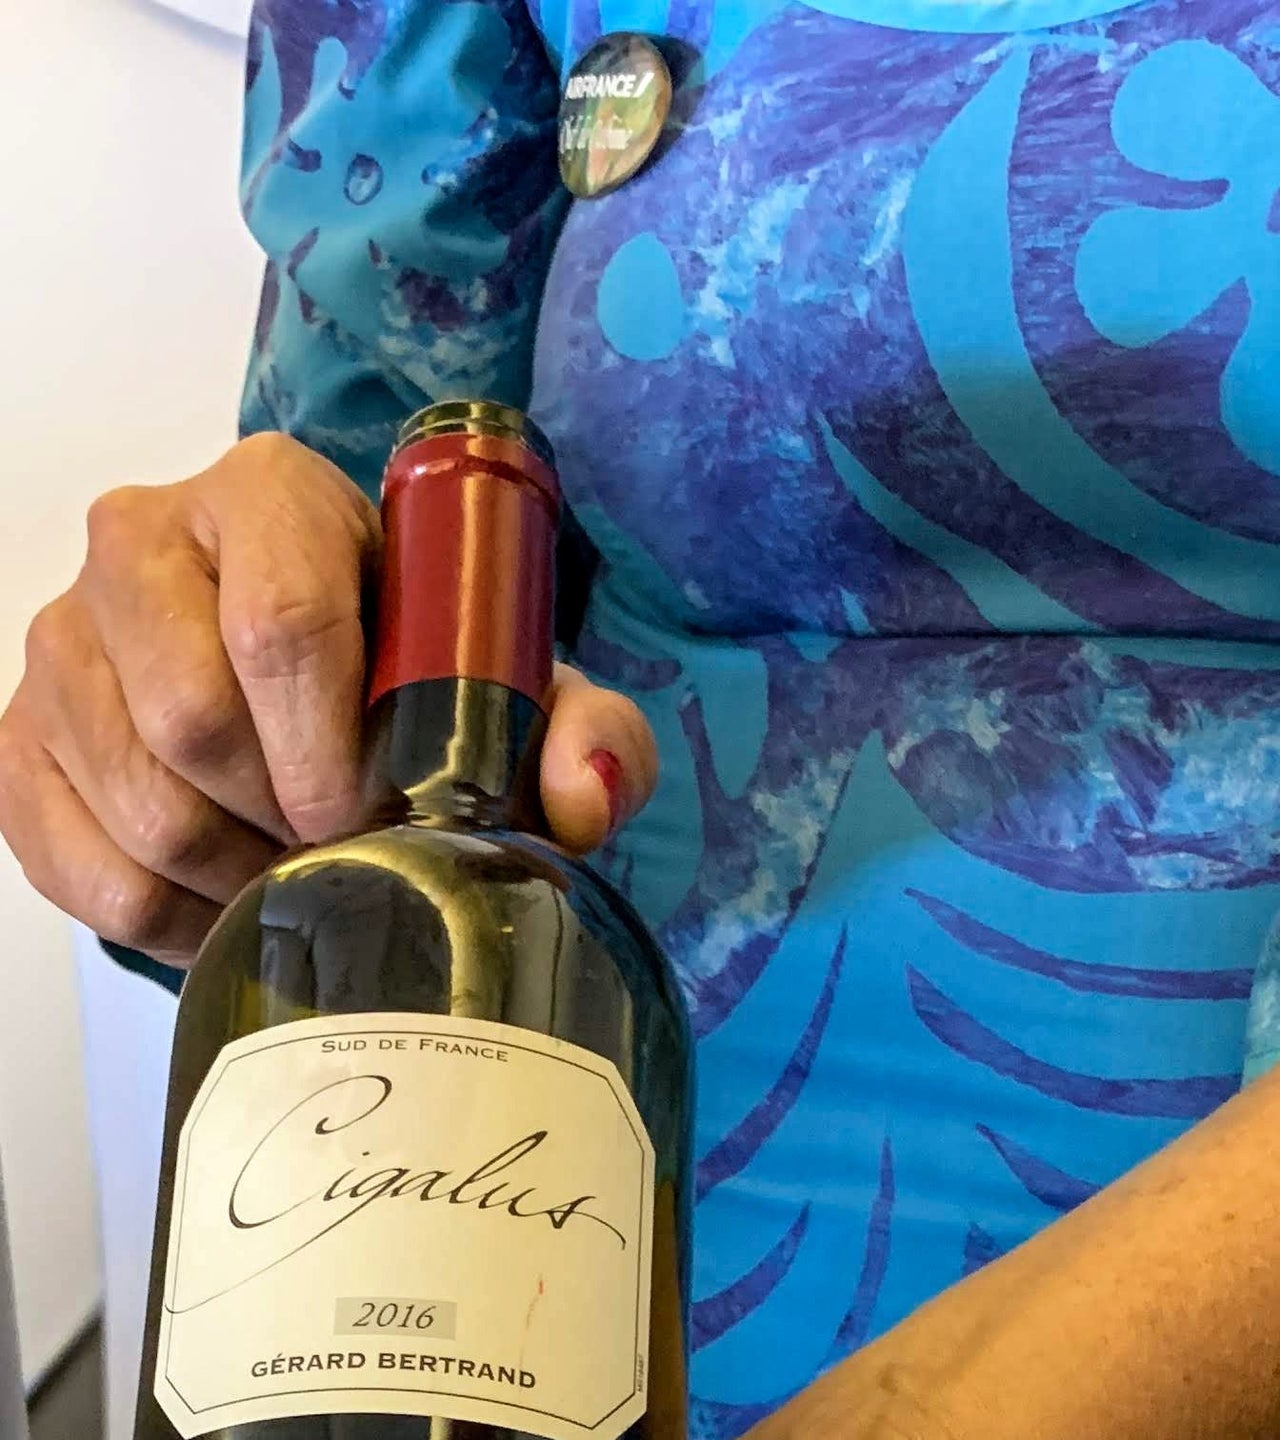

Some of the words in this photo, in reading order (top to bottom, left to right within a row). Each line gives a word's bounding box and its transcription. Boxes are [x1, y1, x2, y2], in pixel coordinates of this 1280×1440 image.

[378, 1039, 407, 1051] DE
[419, 1038, 509, 1063] FRANCE
[166, 1074, 627, 1314] Cigalus
[352, 1302, 436, 1330] 2016
[251, 1352, 367, 1378] GÉRARD
[377, 1352, 537, 1389] BERTRAND
